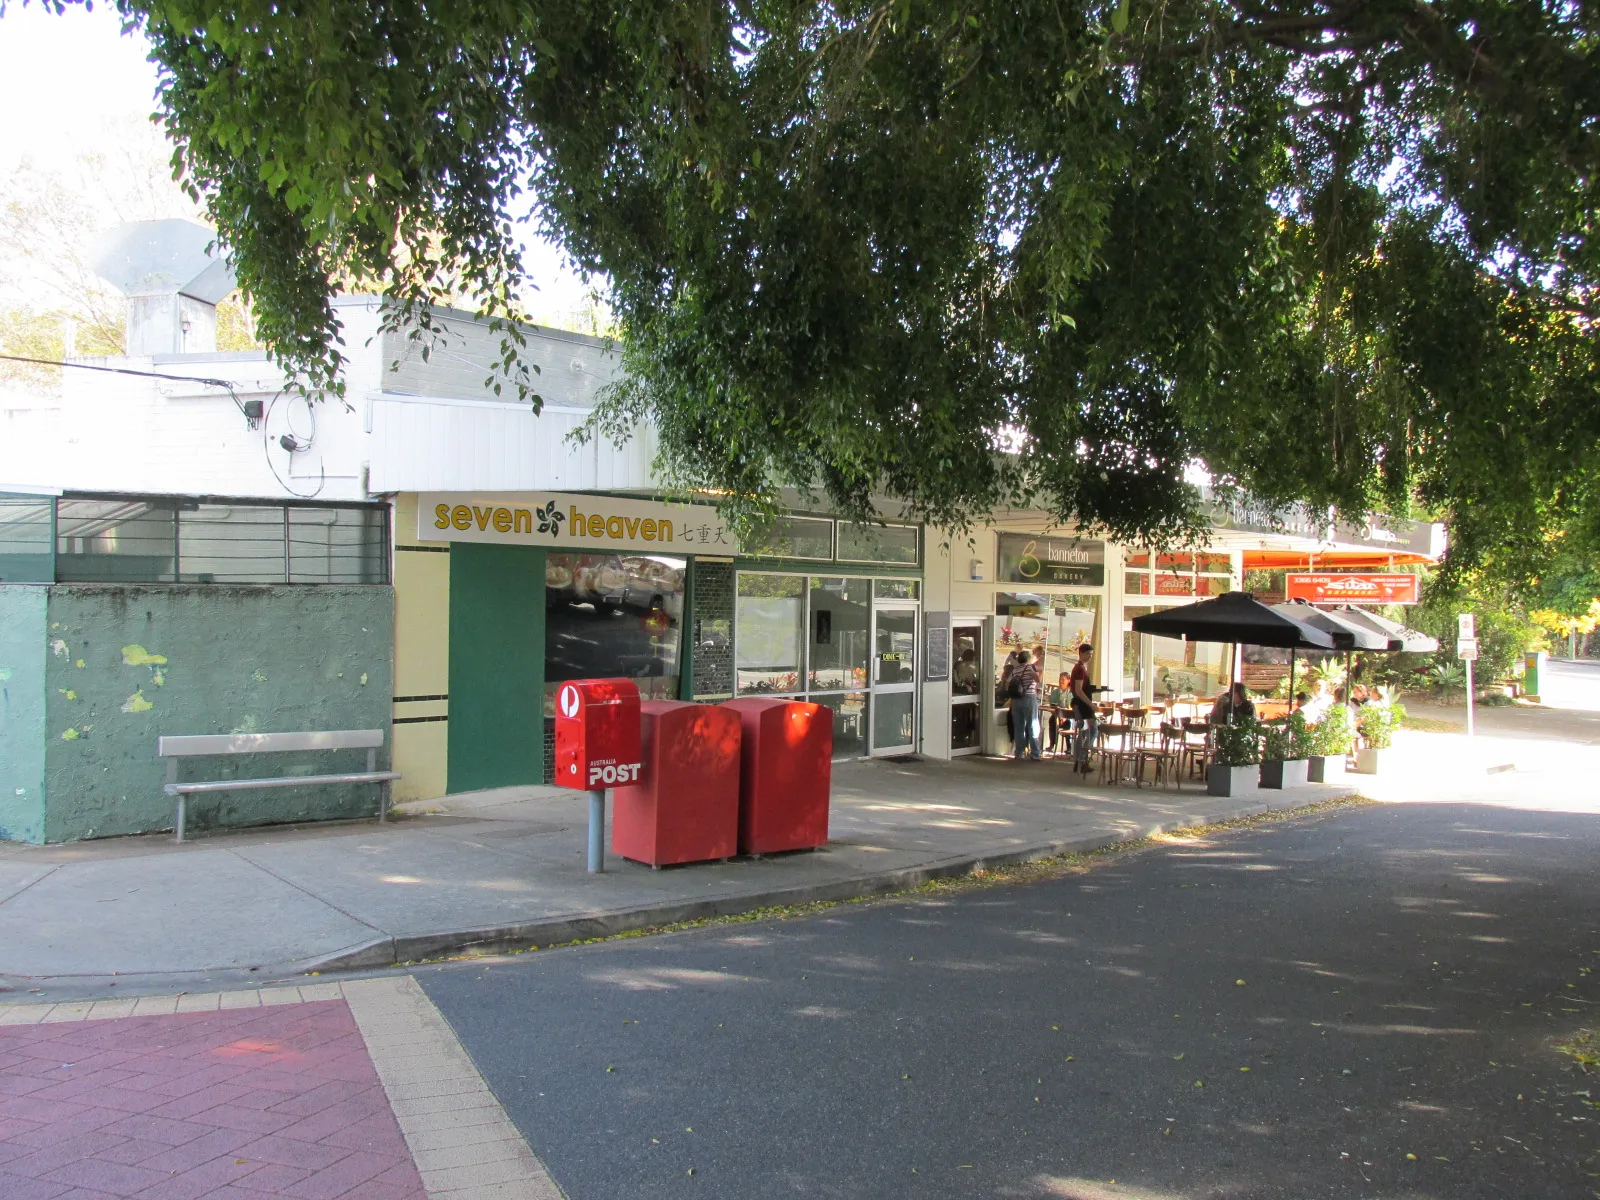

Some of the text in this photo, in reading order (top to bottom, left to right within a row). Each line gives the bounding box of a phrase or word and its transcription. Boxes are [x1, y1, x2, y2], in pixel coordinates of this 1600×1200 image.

[434, 503, 673, 542] seven heaven
[677, 522, 729, 545] 七重天
[1048, 541, 1089, 563] banneton
[589, 758, 617, 767] AUSTRALIA
[589, 763, 641, 786] POST
